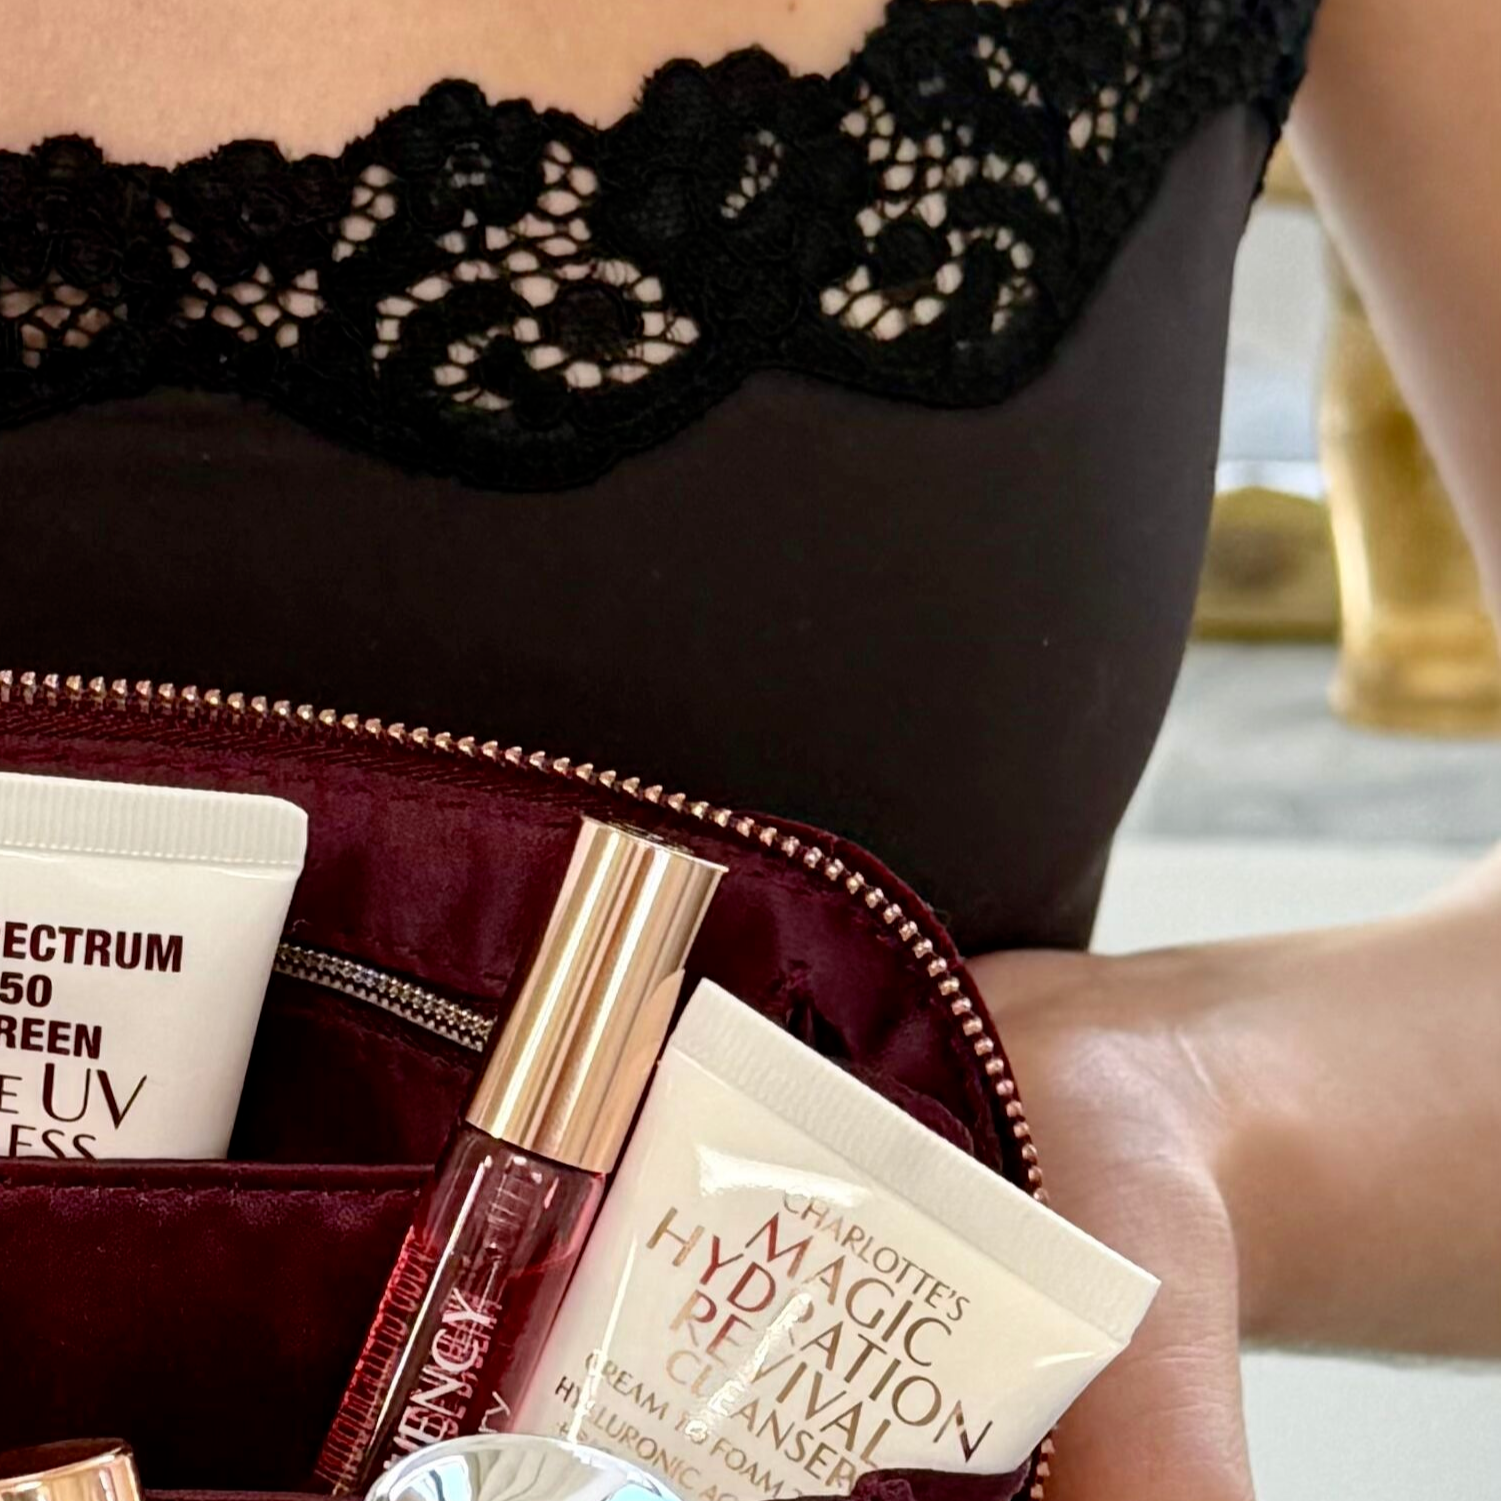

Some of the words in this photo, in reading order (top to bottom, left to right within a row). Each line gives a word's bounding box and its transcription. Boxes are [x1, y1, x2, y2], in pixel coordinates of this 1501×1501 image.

[41, 1062, 148, 1130] UV
[745, 1211, 953, 1368] MAGIC
[783, 1193, 971, 1322] CHARLOTTE'S
[555, 1376, 703, 1491] HYLURONIC
[585, 1349, 670, 1422] CREAM
[709, 1437, 786, 1498] FOAM
